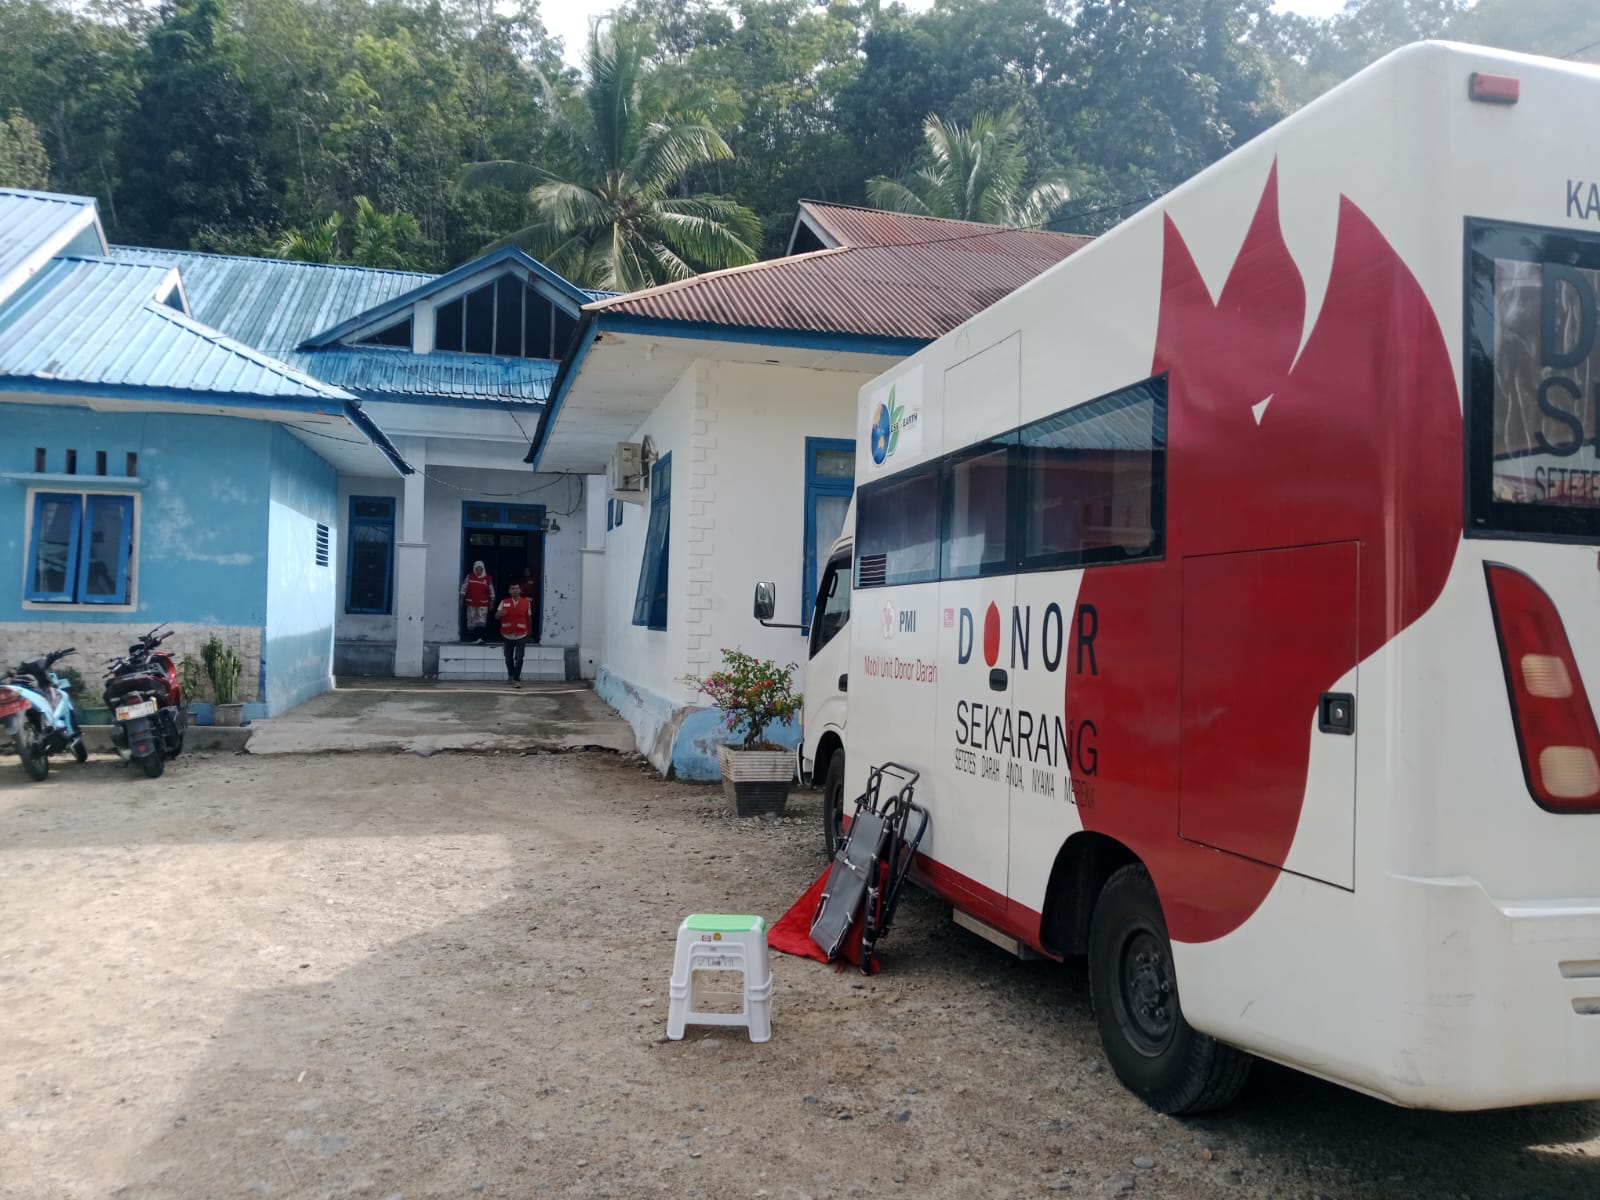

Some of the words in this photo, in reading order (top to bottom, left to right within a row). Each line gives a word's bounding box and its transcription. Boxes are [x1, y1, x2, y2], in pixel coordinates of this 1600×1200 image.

[1535, 376, 1600, 459] S
[899, 610, 916, 633] PMI
[958, 600, 1099, 676] DONOR
[864, 655, 880, 676] Mobil
[881, 656, 893, 678] Unit
[895, 657, 914, 680] Donor
[916, 658, 938, 683] Darah
[955, 700, 1098, 777] SEKARANG
[955, 748, 976, 775] SETETES
[981, 755, 1000, 782] DARAH
[1032, 767, 1055, 798] NYAWA
